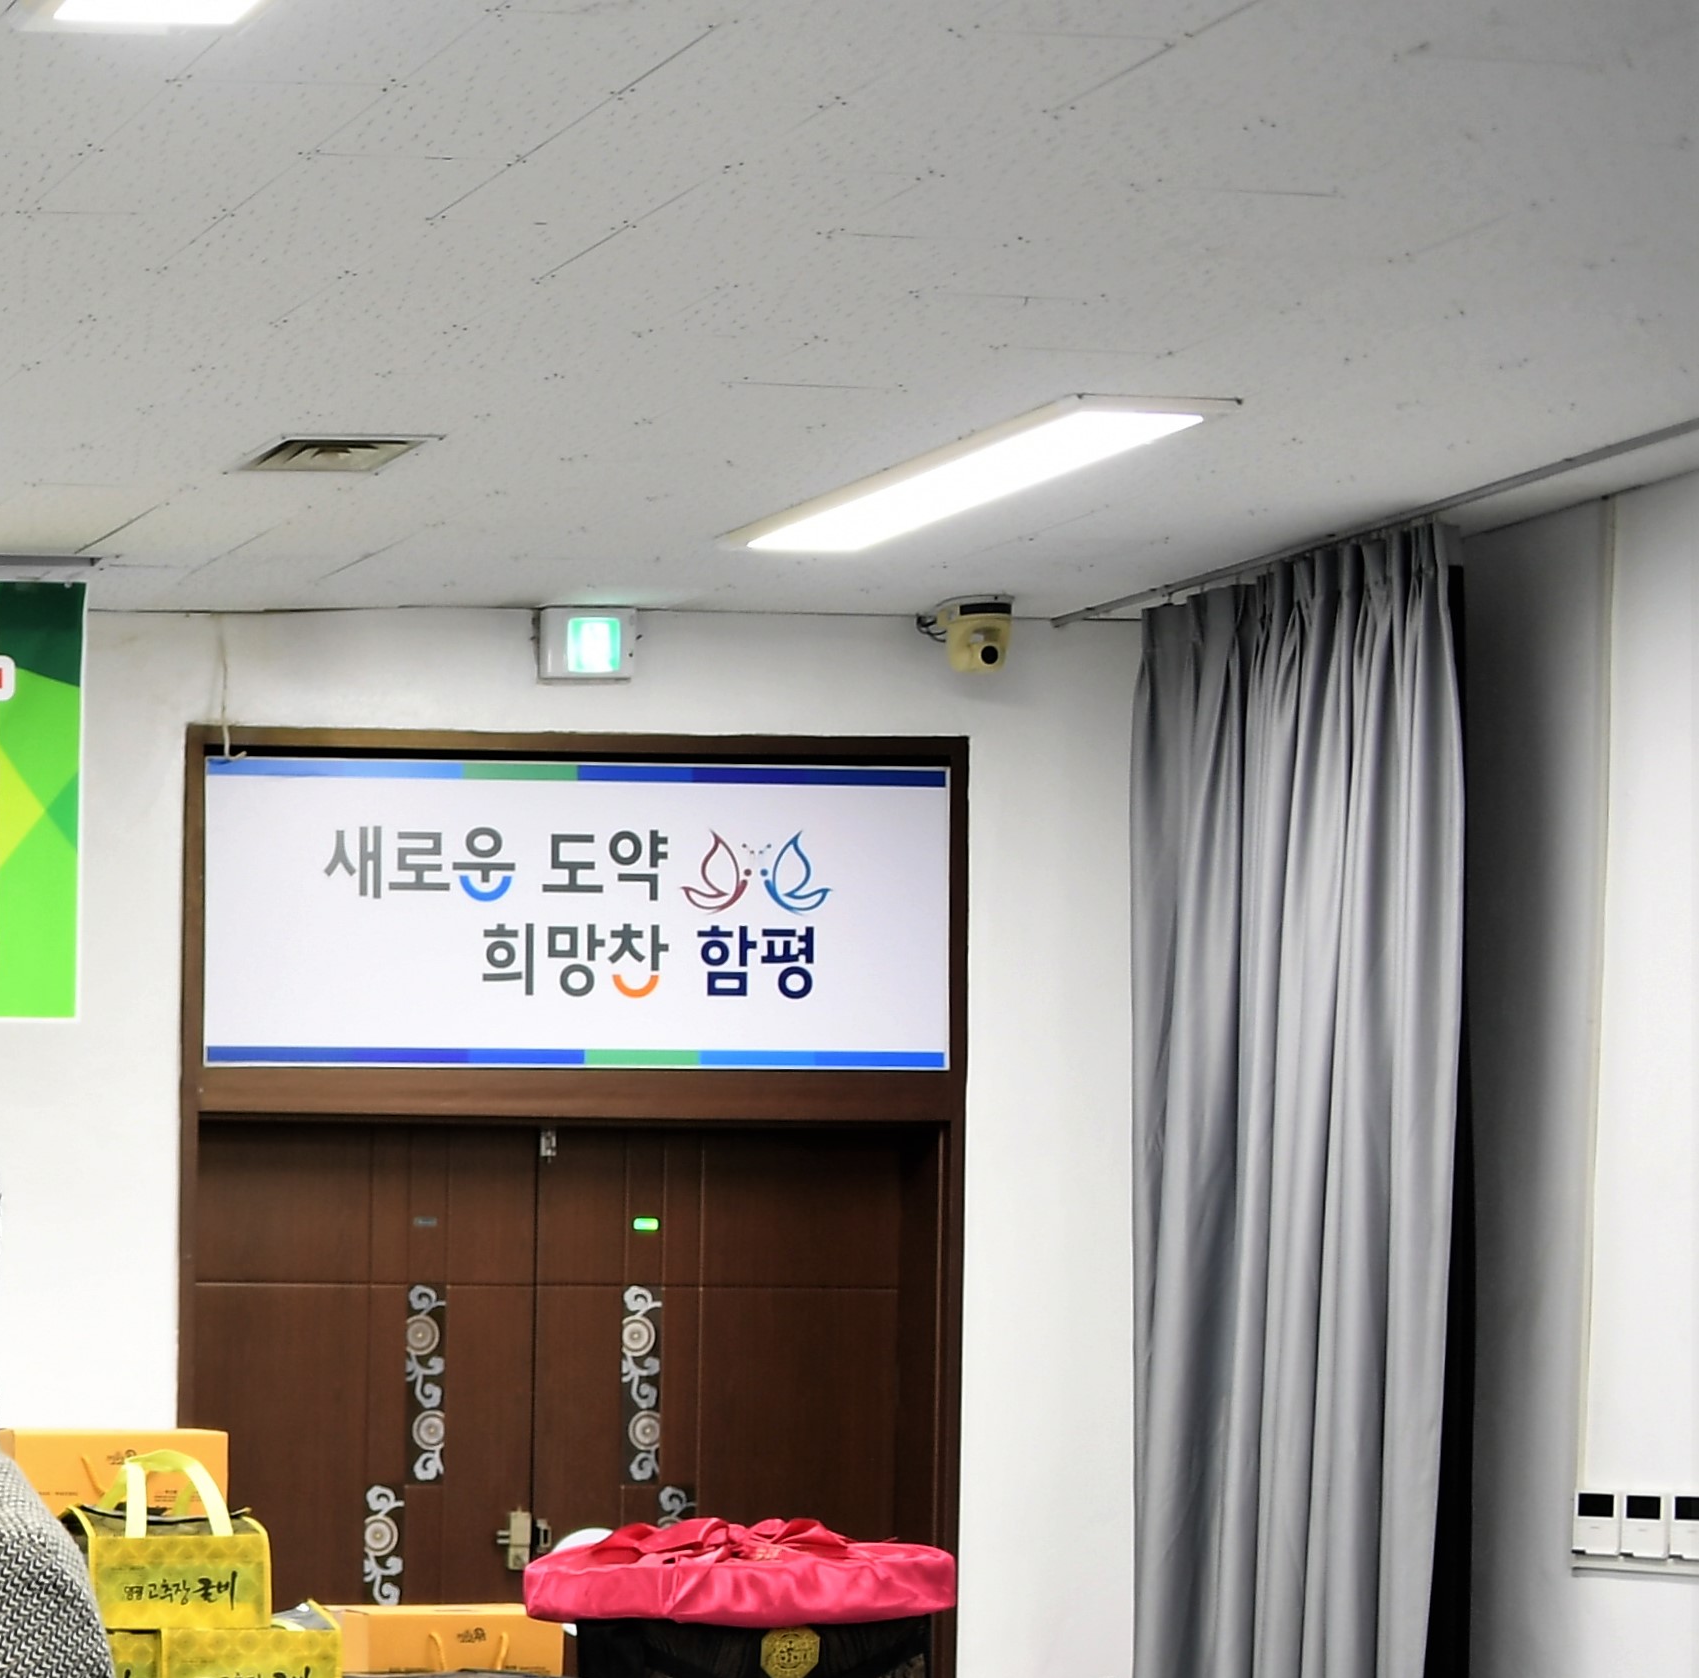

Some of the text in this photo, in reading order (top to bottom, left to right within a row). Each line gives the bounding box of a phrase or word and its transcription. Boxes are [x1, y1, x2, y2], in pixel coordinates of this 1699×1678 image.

[321, 823, 670, 903] 새로운 도약
[480, 921, 817, 1001] 희망찬 함평
[147, 1578, 191, 1606] 고추장
[192, 1570, 238, 1611] 굴비
